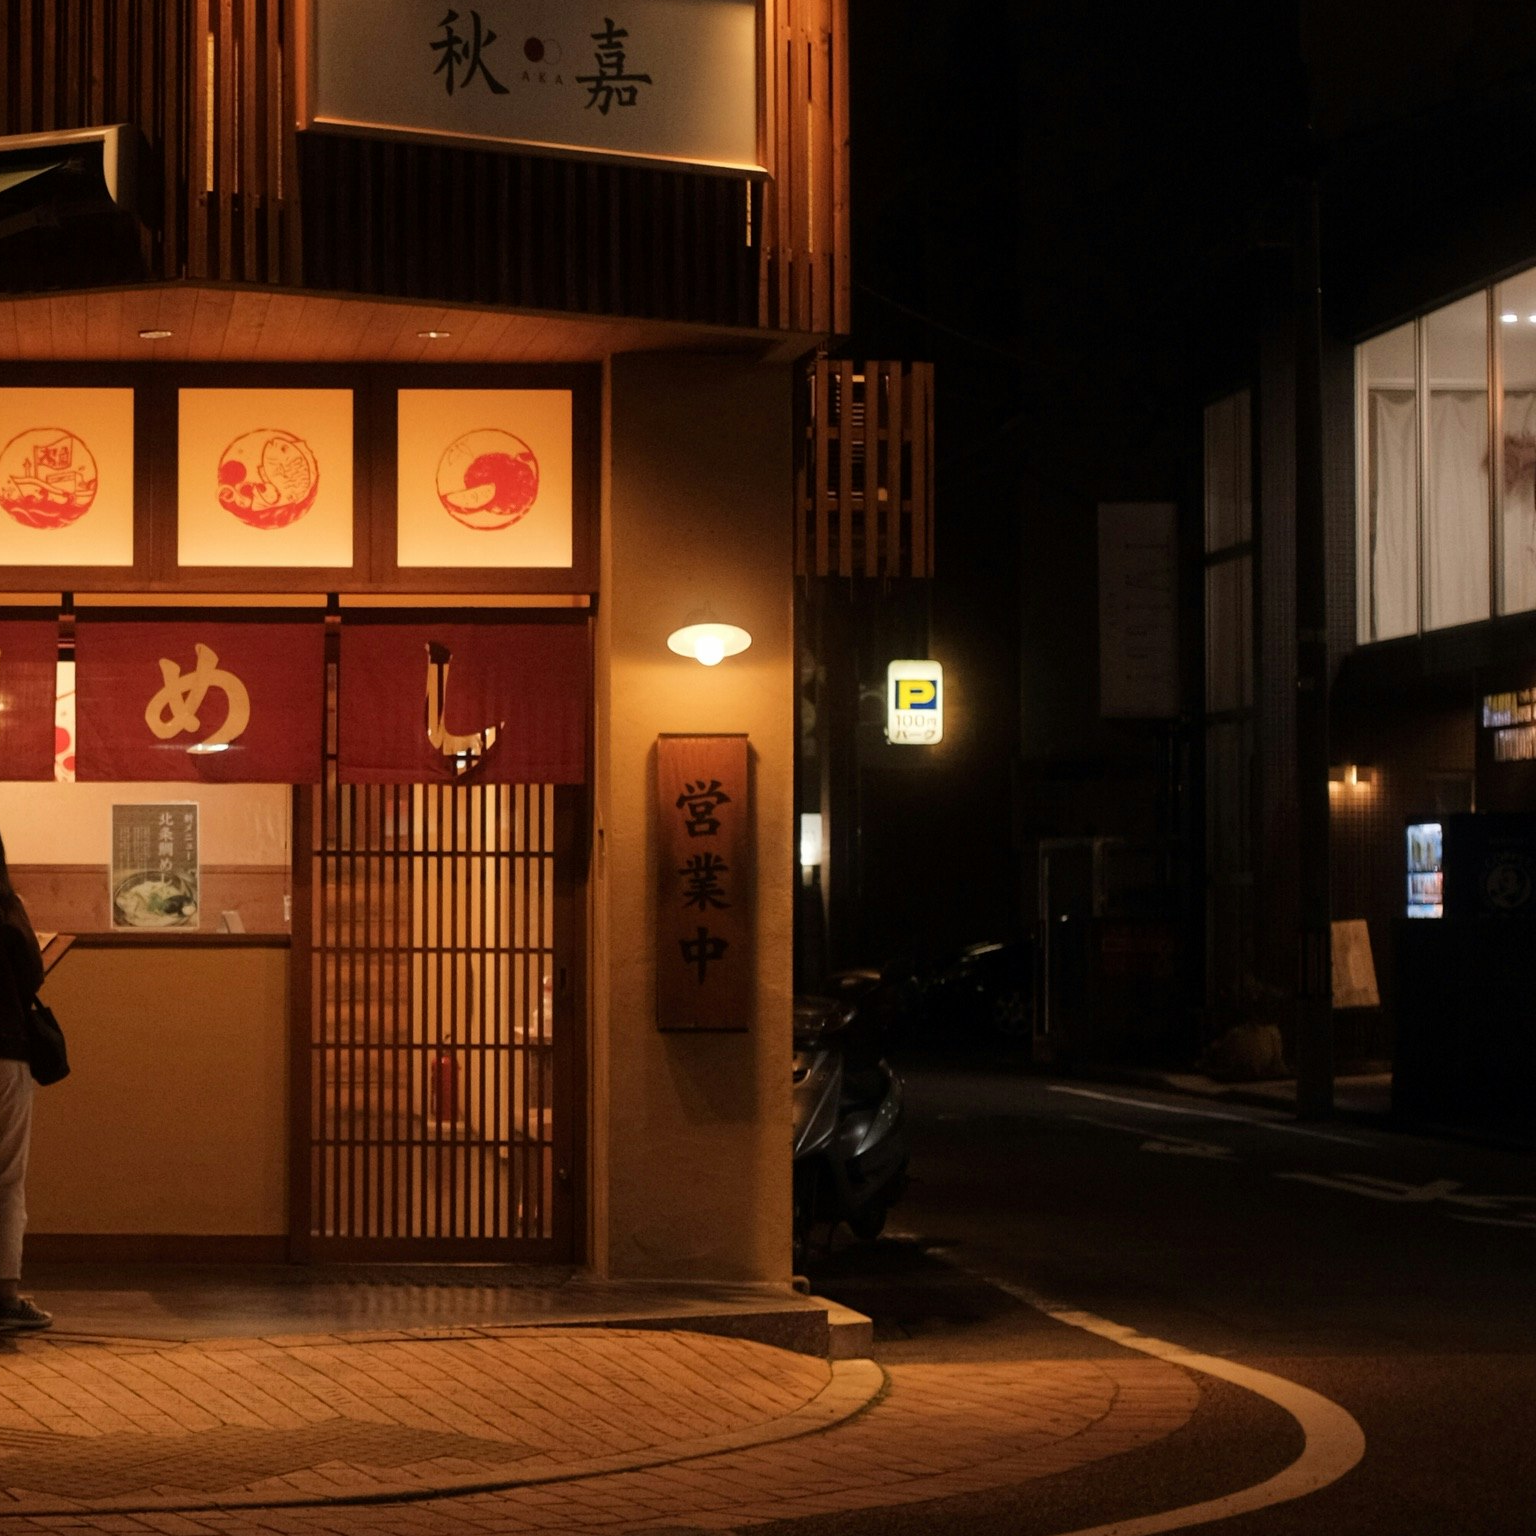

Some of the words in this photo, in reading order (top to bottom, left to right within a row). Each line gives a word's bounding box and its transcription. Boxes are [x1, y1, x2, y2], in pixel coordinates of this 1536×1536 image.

[521, 70, 564, 86] AKA
[898, 679, 935, 710] P
[675, 779, 732, 986] 営業中
